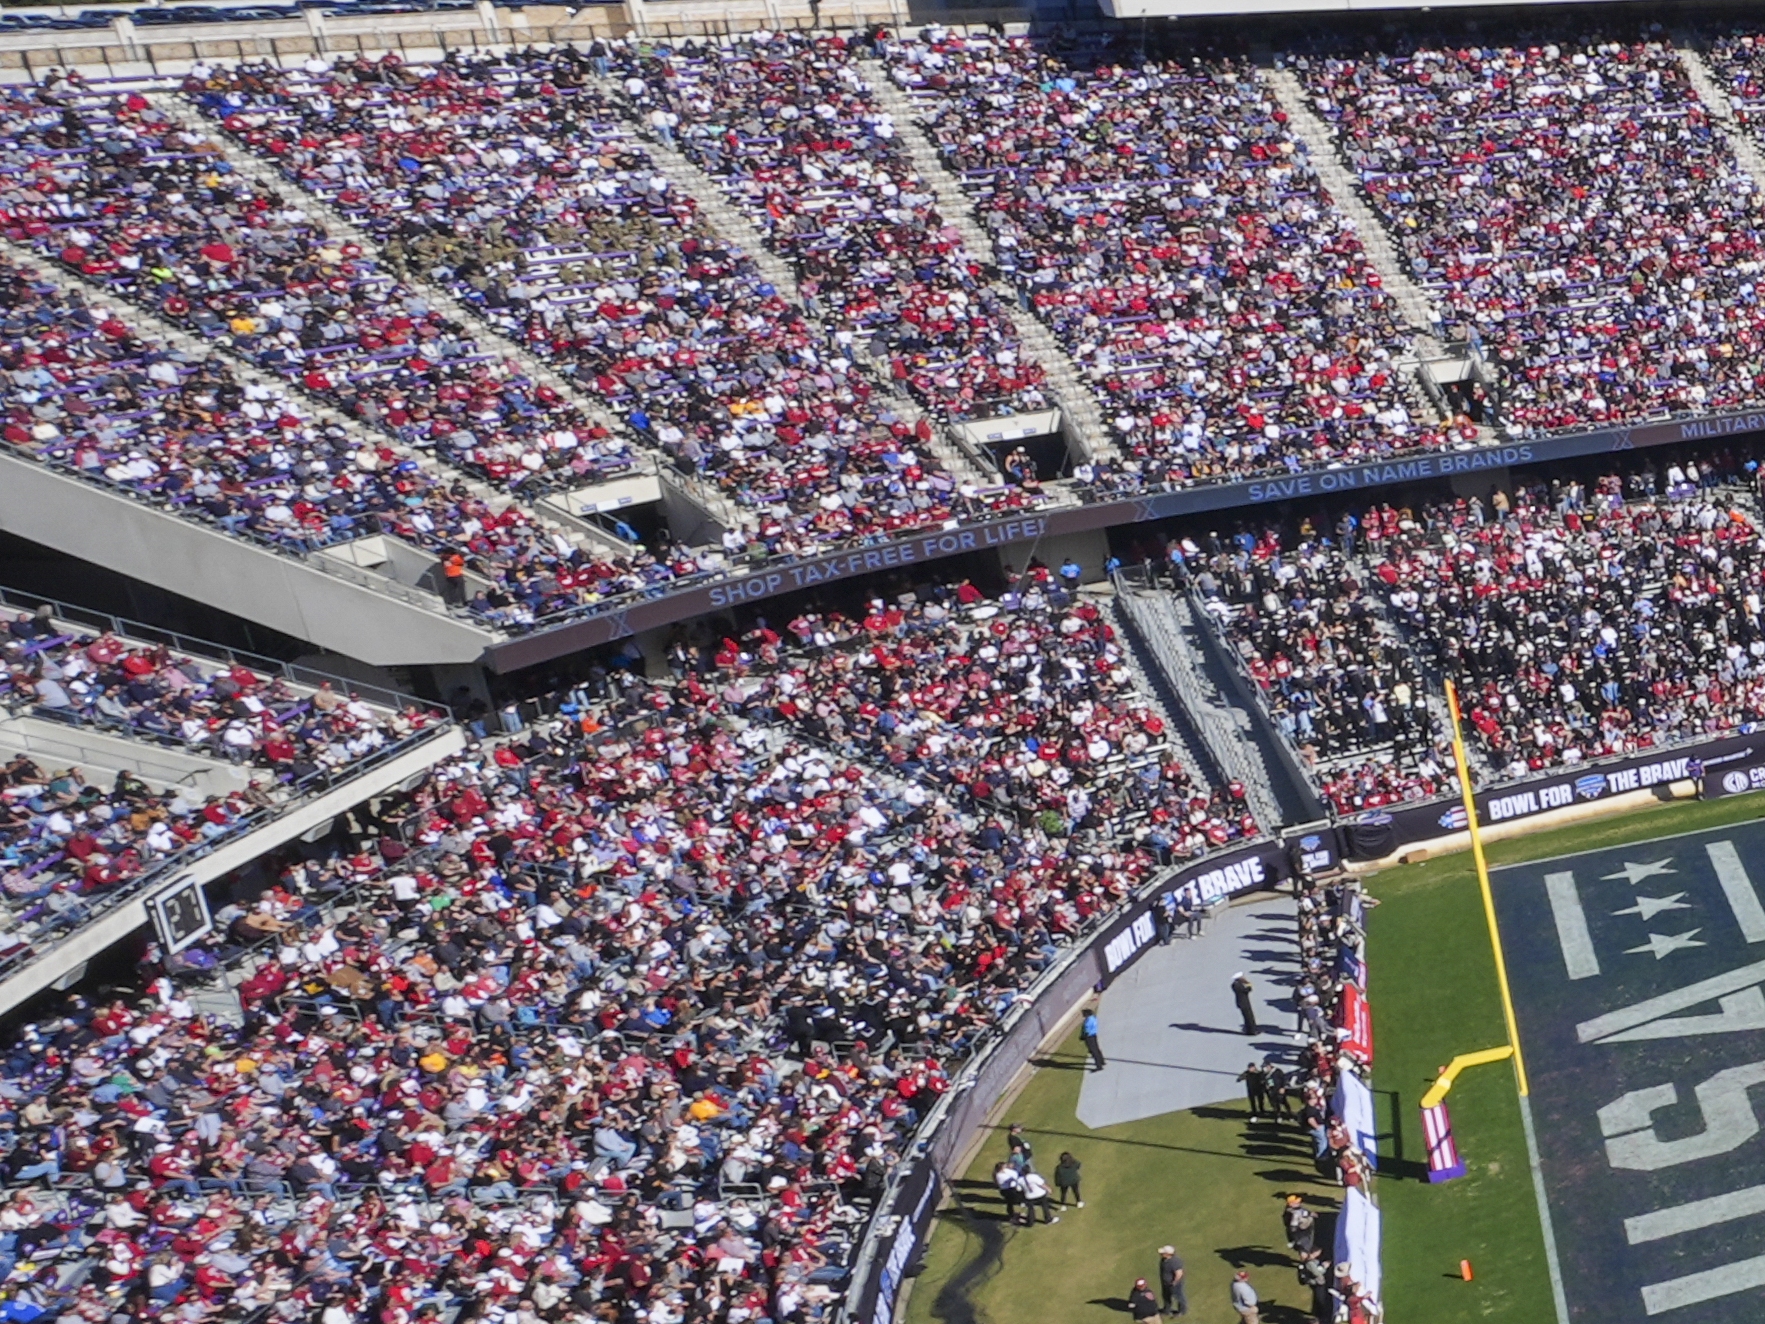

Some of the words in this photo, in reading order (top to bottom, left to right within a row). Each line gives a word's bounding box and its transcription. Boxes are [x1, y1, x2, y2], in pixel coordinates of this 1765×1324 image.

[1248, 477, 1312, 503] SAVE
[1318, 473, 1358, 494] ON
[1364, 459, 1434, 489] NAME
[1438, 444, 1534, 478] BRANDS
[709, 572, 783, 607] SHOP
[793, 541, 916, 588] TAX-FREE
[921, 529, 978, 560] FOR
[983, 516, 1046, 550] LIFE!
[1488, 788, 1537, 822] BOWL
[1538, 782, 1574, 813] FOR
[1607, 769, 1638, 794] THE
[1200, 855, 1266, 902] BRAVE
